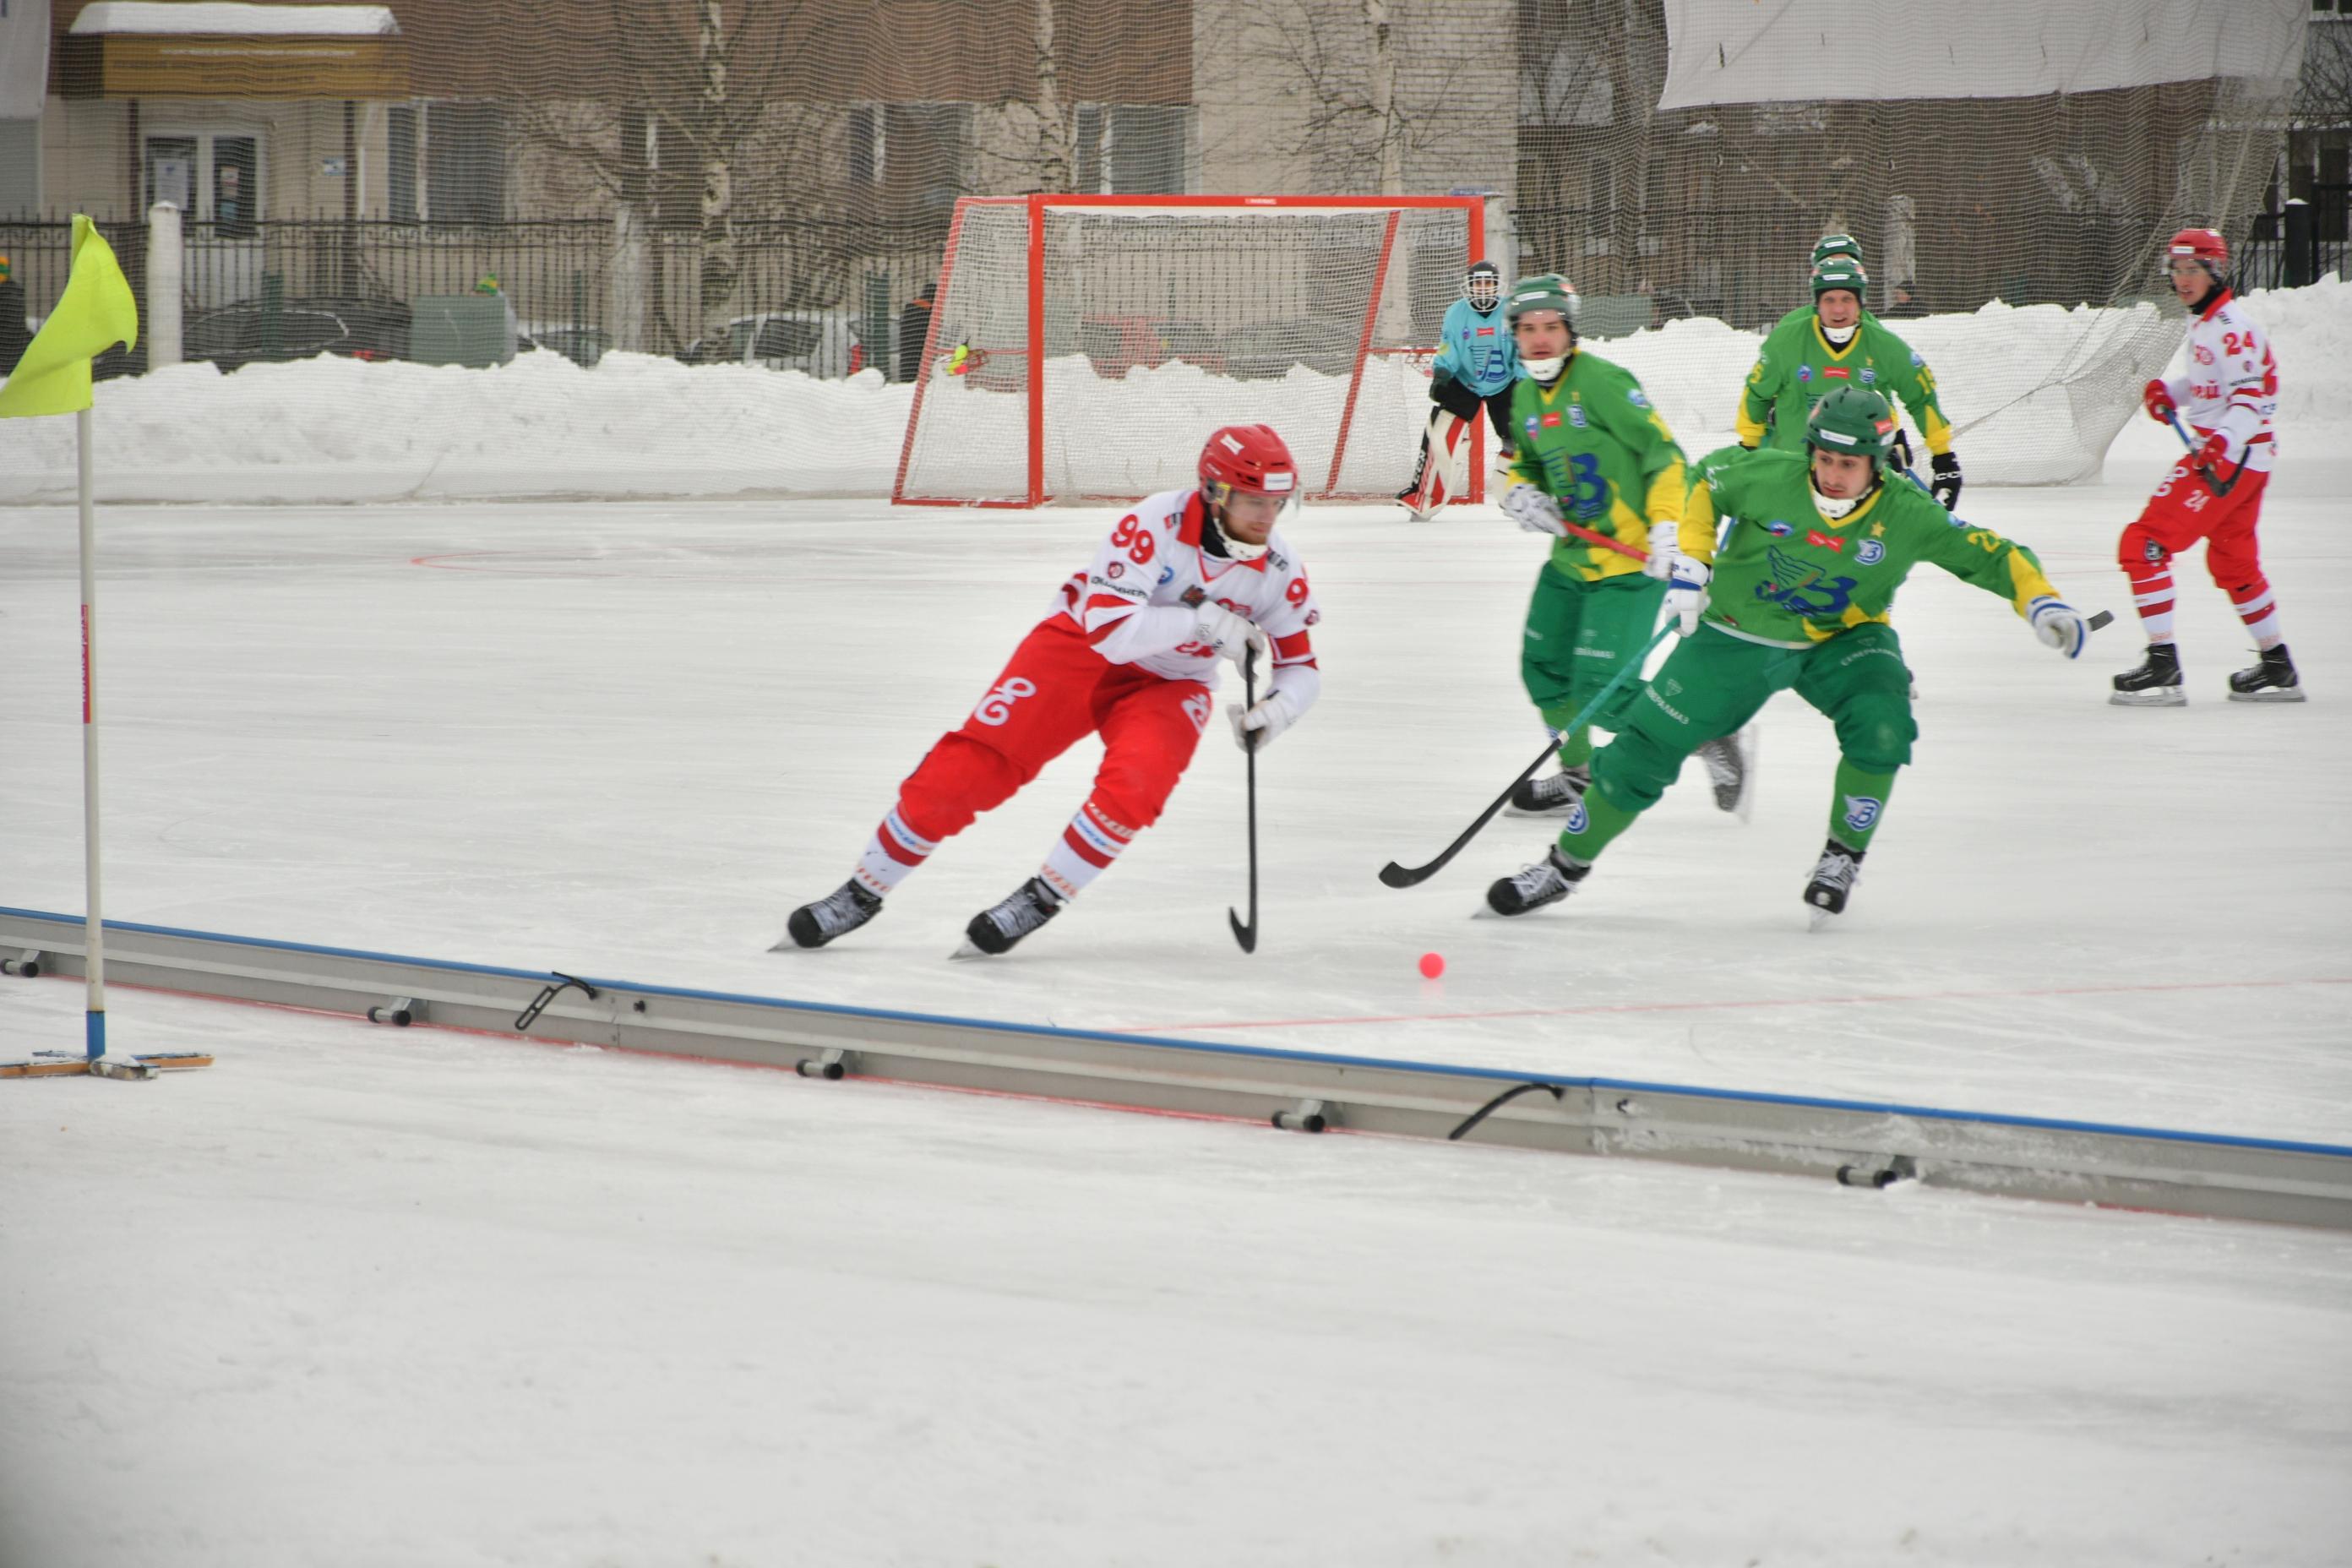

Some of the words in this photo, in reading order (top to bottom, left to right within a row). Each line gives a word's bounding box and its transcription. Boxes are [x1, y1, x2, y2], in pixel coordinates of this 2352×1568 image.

[2222, 330, 2257, 357] 24
[1914, 365, 1938, 395] 15
[1111, 514, 1155, 565] 99
